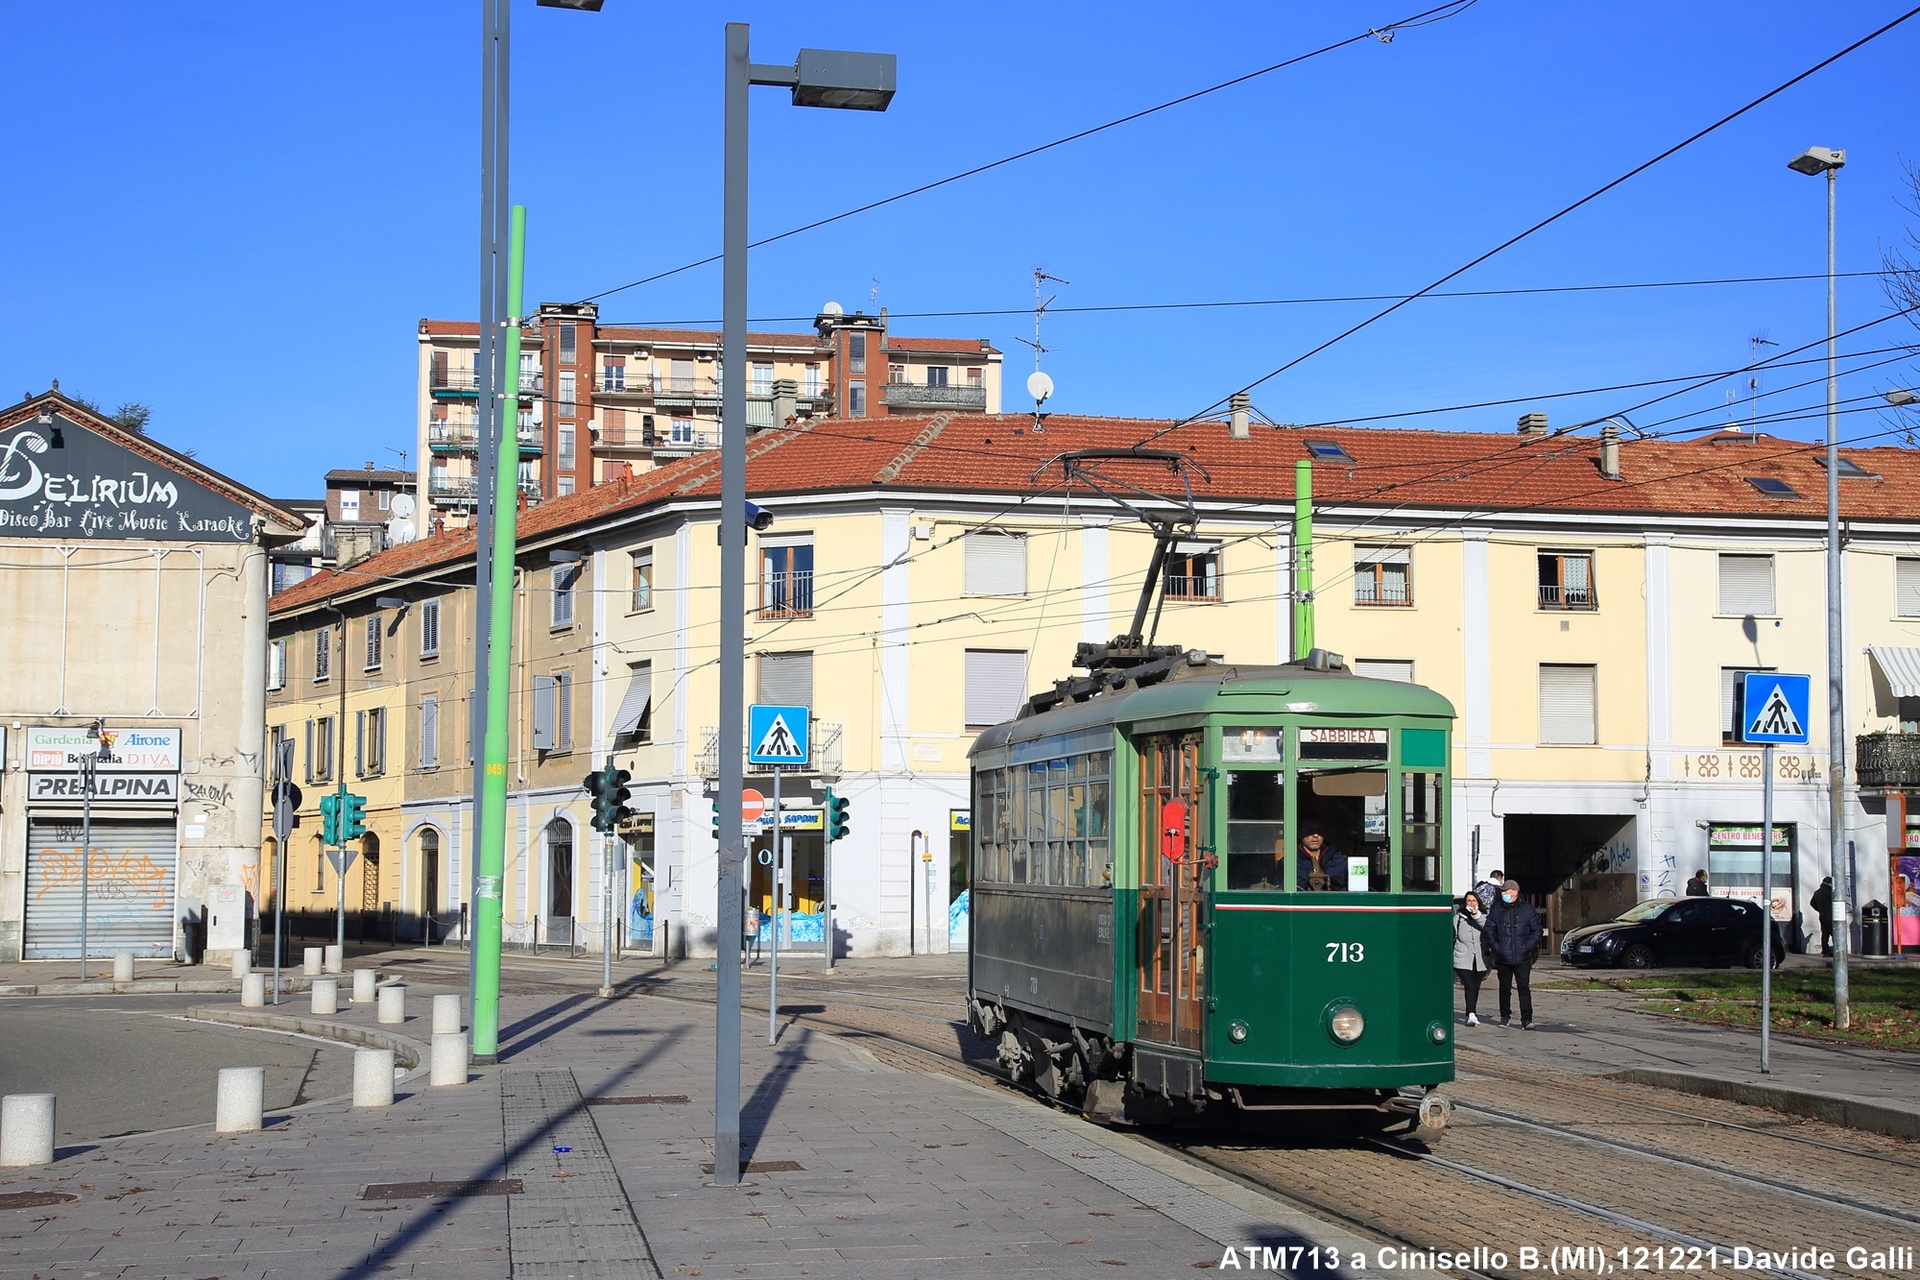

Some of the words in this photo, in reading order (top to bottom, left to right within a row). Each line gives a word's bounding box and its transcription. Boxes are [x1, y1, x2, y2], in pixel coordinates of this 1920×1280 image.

[37, 503, 72, 532] Bar
[79, 507, 114, 536] Live
[118, 509, 168, 532] Music
[176, 510, 250, 540] Karaoke
[35, 734, 93, 745] Gardenia
[124, 733, 171, 746] Airone
[1310, 729, 1376, 743] SABBIERA
[128, 753, 171, 765] DIVA
[486, 763, 507, 776] 9451
[37, 778, 171, 795] PREALPINA
[784, 814, 819, 824] SAPONE
[1712, 831, 1741, 840] CENTRO
[1353, 865, 1366, 875] 73
[1325, 942, 1365, 963] 713
